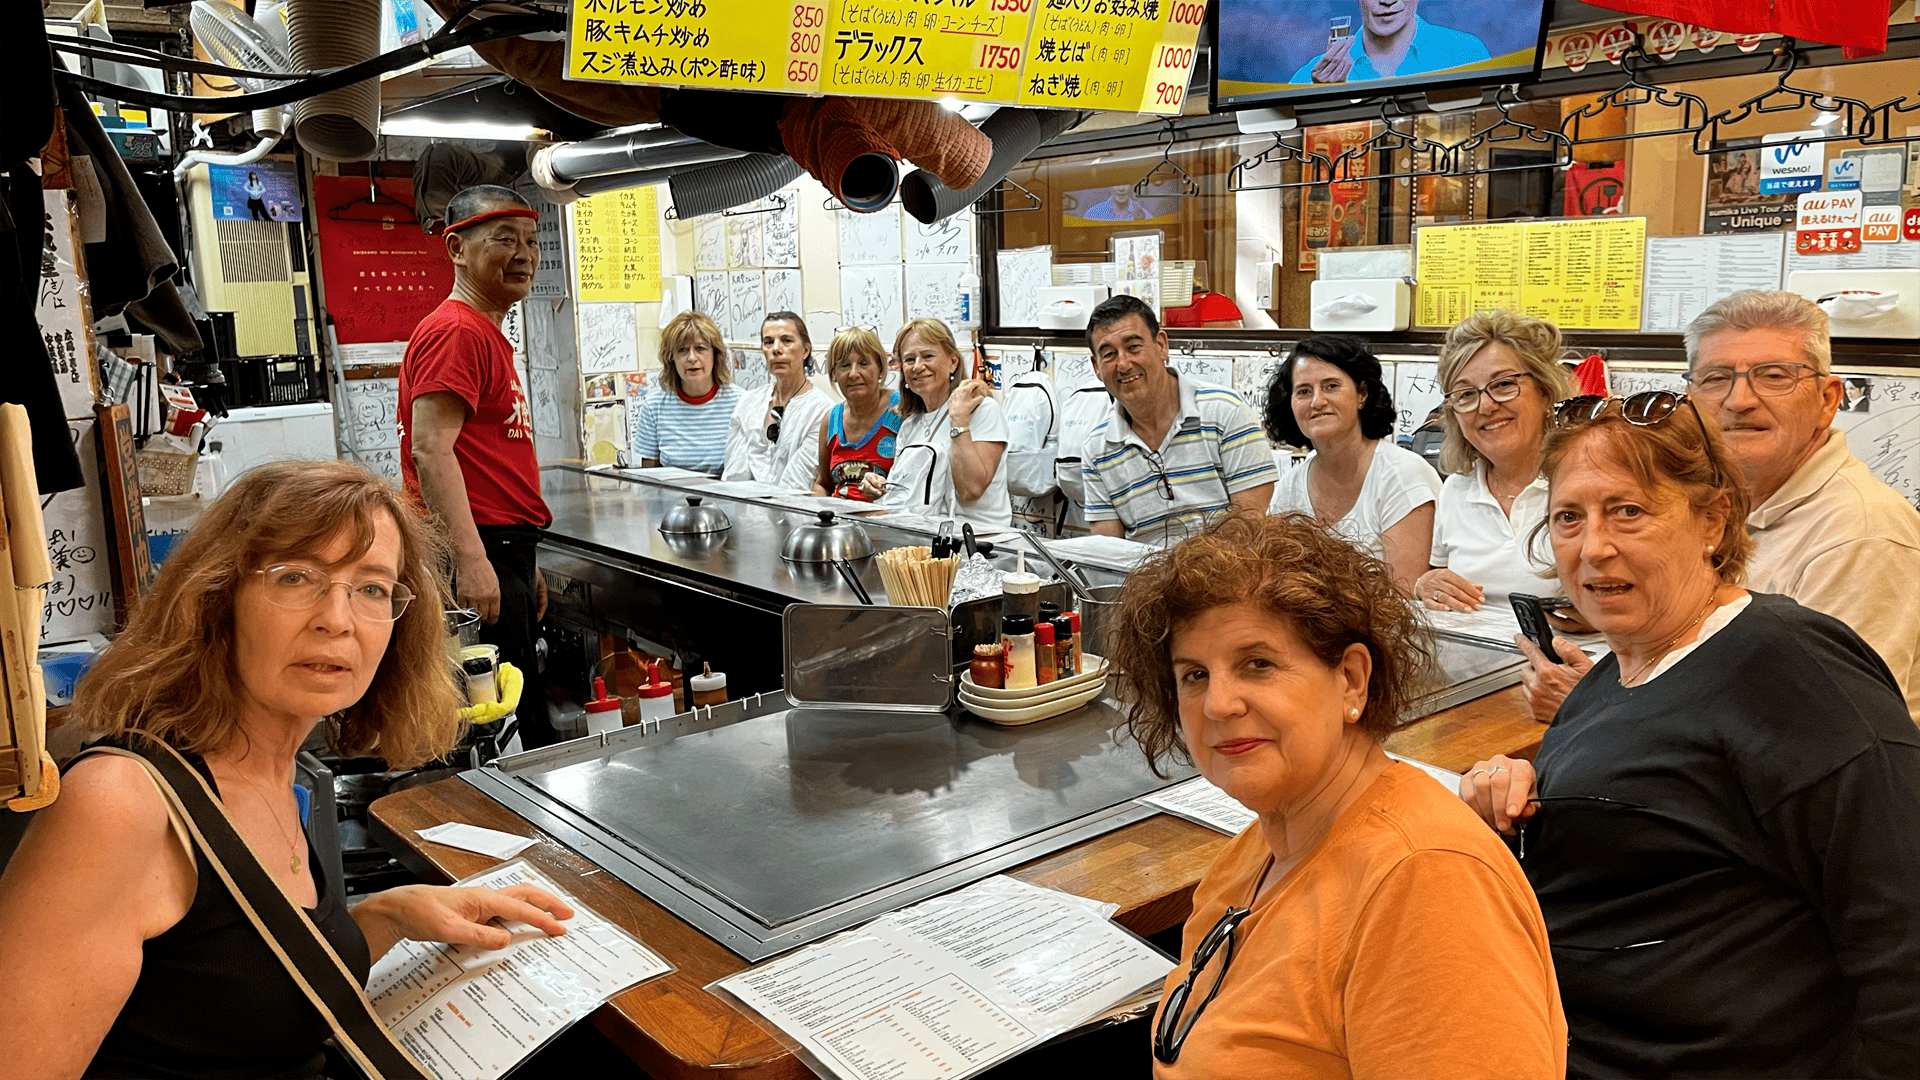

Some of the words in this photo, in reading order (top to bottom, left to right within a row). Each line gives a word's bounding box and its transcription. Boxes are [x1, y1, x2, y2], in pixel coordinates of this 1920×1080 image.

[792, 5, 823, 28] 850
[1168, 1, 1205, 25] 1000
[585, 18, 710, 48] 豚キムチ炒め
[790, 32, 820, 54] 800
[835, 29, 925, 65] デラックス
[979, 45, 1020, 69] 1750
[1157, 46, 1192, 69] 1000
[787, 60, 818, 82] 650
[1029, 72, 1082, 98] ねぎ焼
[1156, 82, 1182, 105] 900
[620, 201, 637, 209] キムチ
[1709, 208, 1739, 217] sumika
[1741, 206, 1758, 215] Live
[1761, 205, 1781, 213] Tour
[1803, 200, 1830, 210] au
[1831, 198, 1855, 209] PAY
[622, 219, 639, 227] チーズ
[1731, 215, 1782, 229] Unique
[1869, 213, 1895, 223] au
[1868, 226, 1893, 236] PAY
[507, 428, 523, 439] DAI
